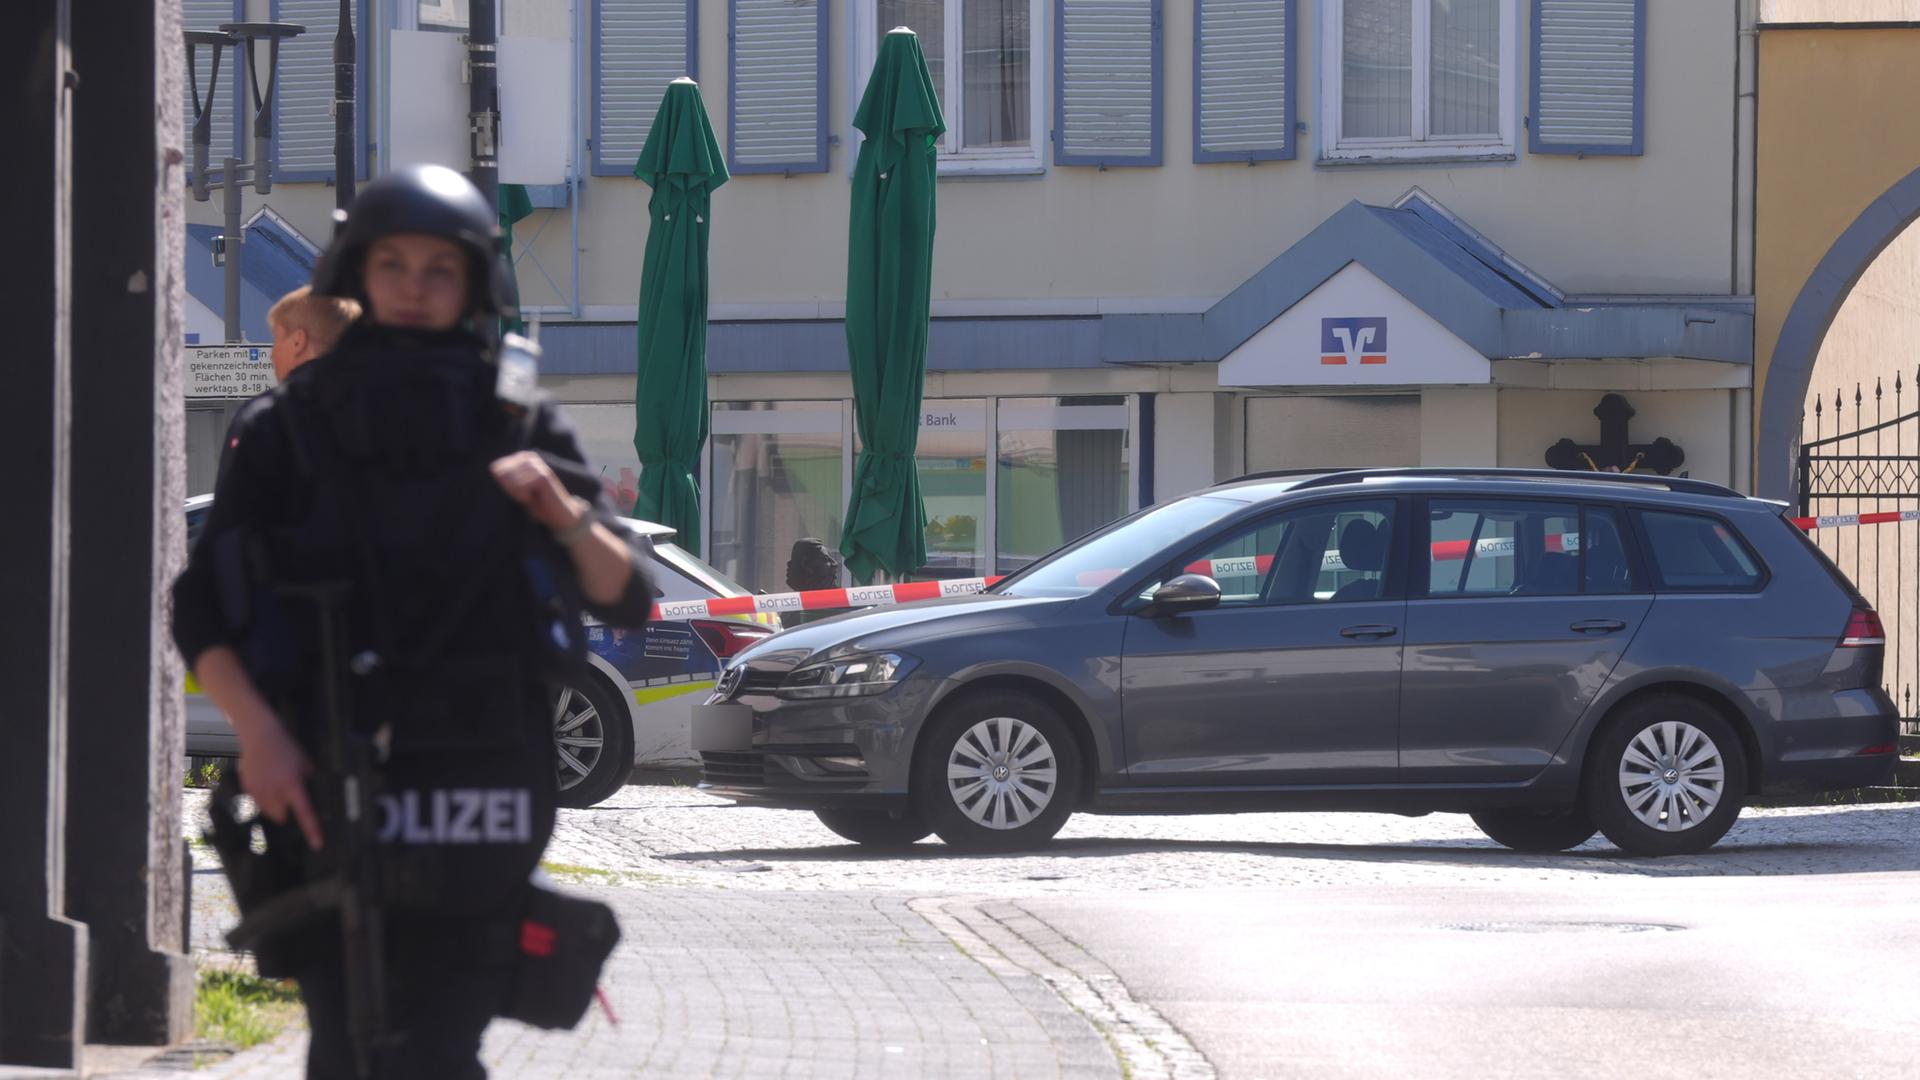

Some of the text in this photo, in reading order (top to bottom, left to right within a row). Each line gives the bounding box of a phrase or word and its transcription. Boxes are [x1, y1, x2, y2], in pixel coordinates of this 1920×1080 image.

[196, 350, 267, 359] Parken mit in
[190, 361, 274, 372] gekennzeichneten
[195, 372, 232, 381] Flächen
[234, 372, 247, 381] 30
[194, 384, 238, 394] werktags
[241, 384, 261, 393] 8-18
[926, 413, 957, 426] Bank
[376, 788, 532, 844] OLIZEI
